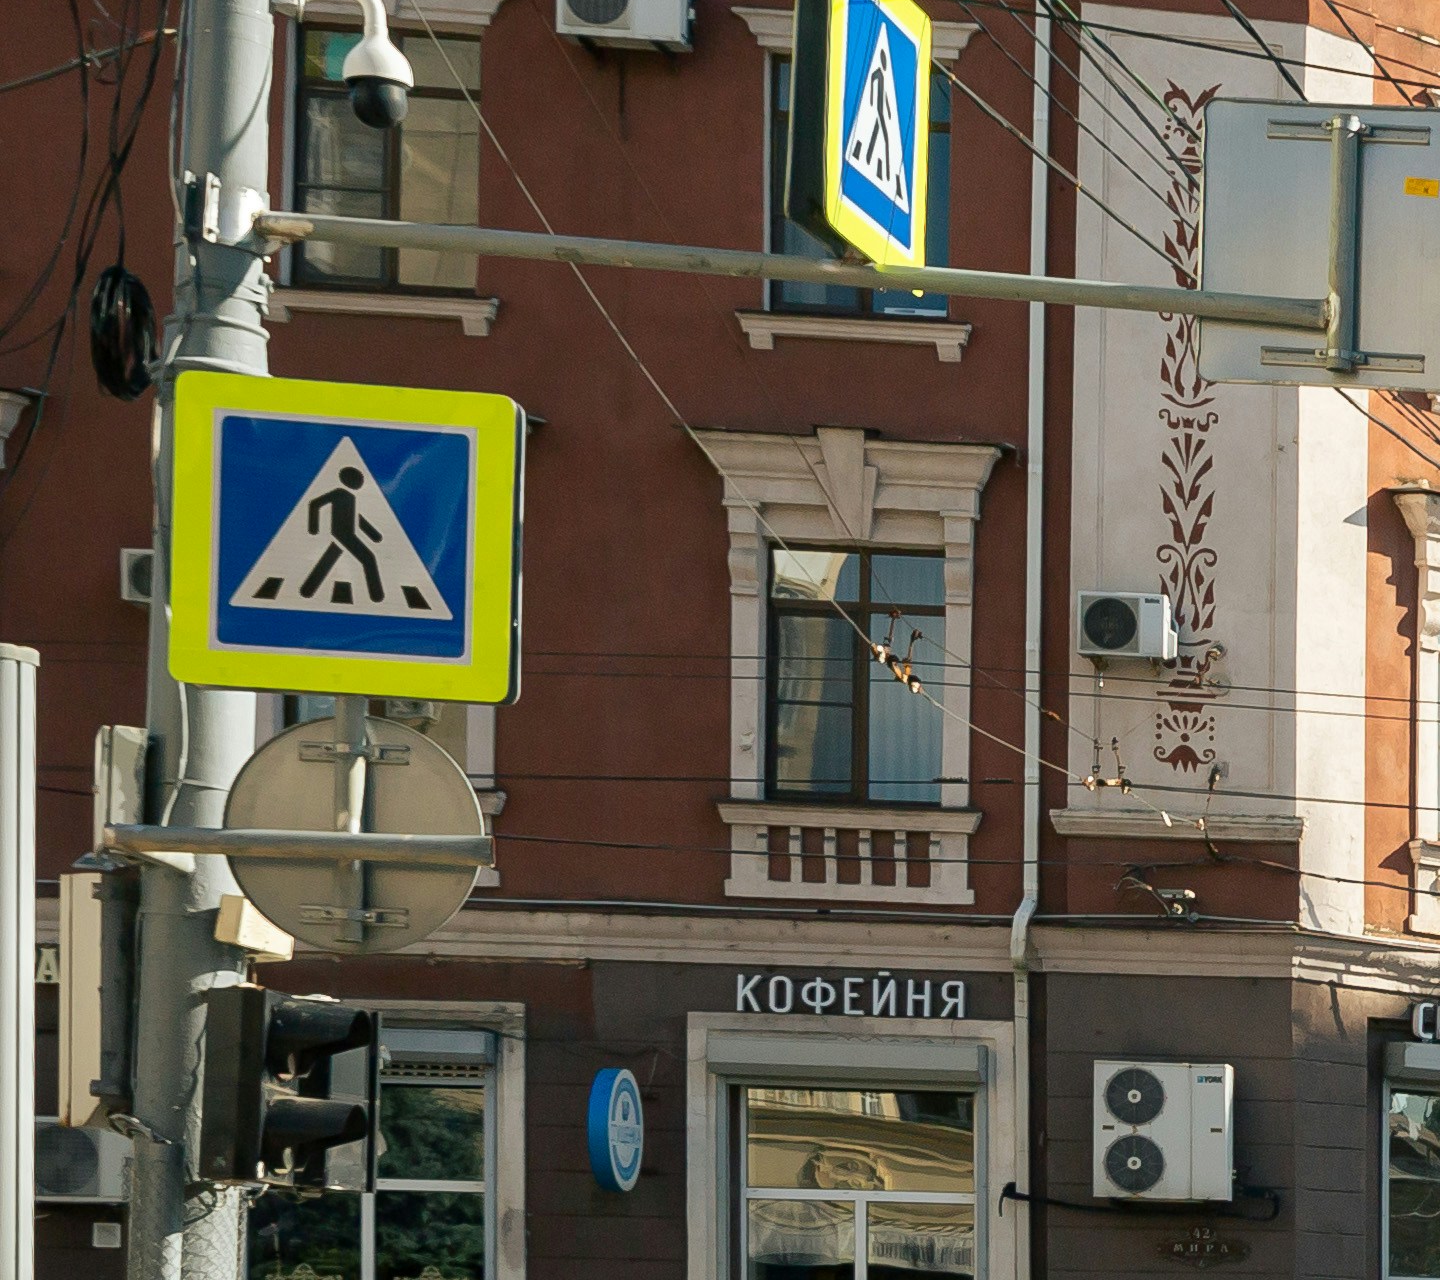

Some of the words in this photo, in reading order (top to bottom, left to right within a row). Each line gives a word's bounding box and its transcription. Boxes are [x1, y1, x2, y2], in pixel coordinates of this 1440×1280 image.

[736, 971, 965, 1018] КОФЕЙНЯ
[1193, 1227, 1211, 1239] 42
[1173, 1243, 1229, 1253] МИРА
